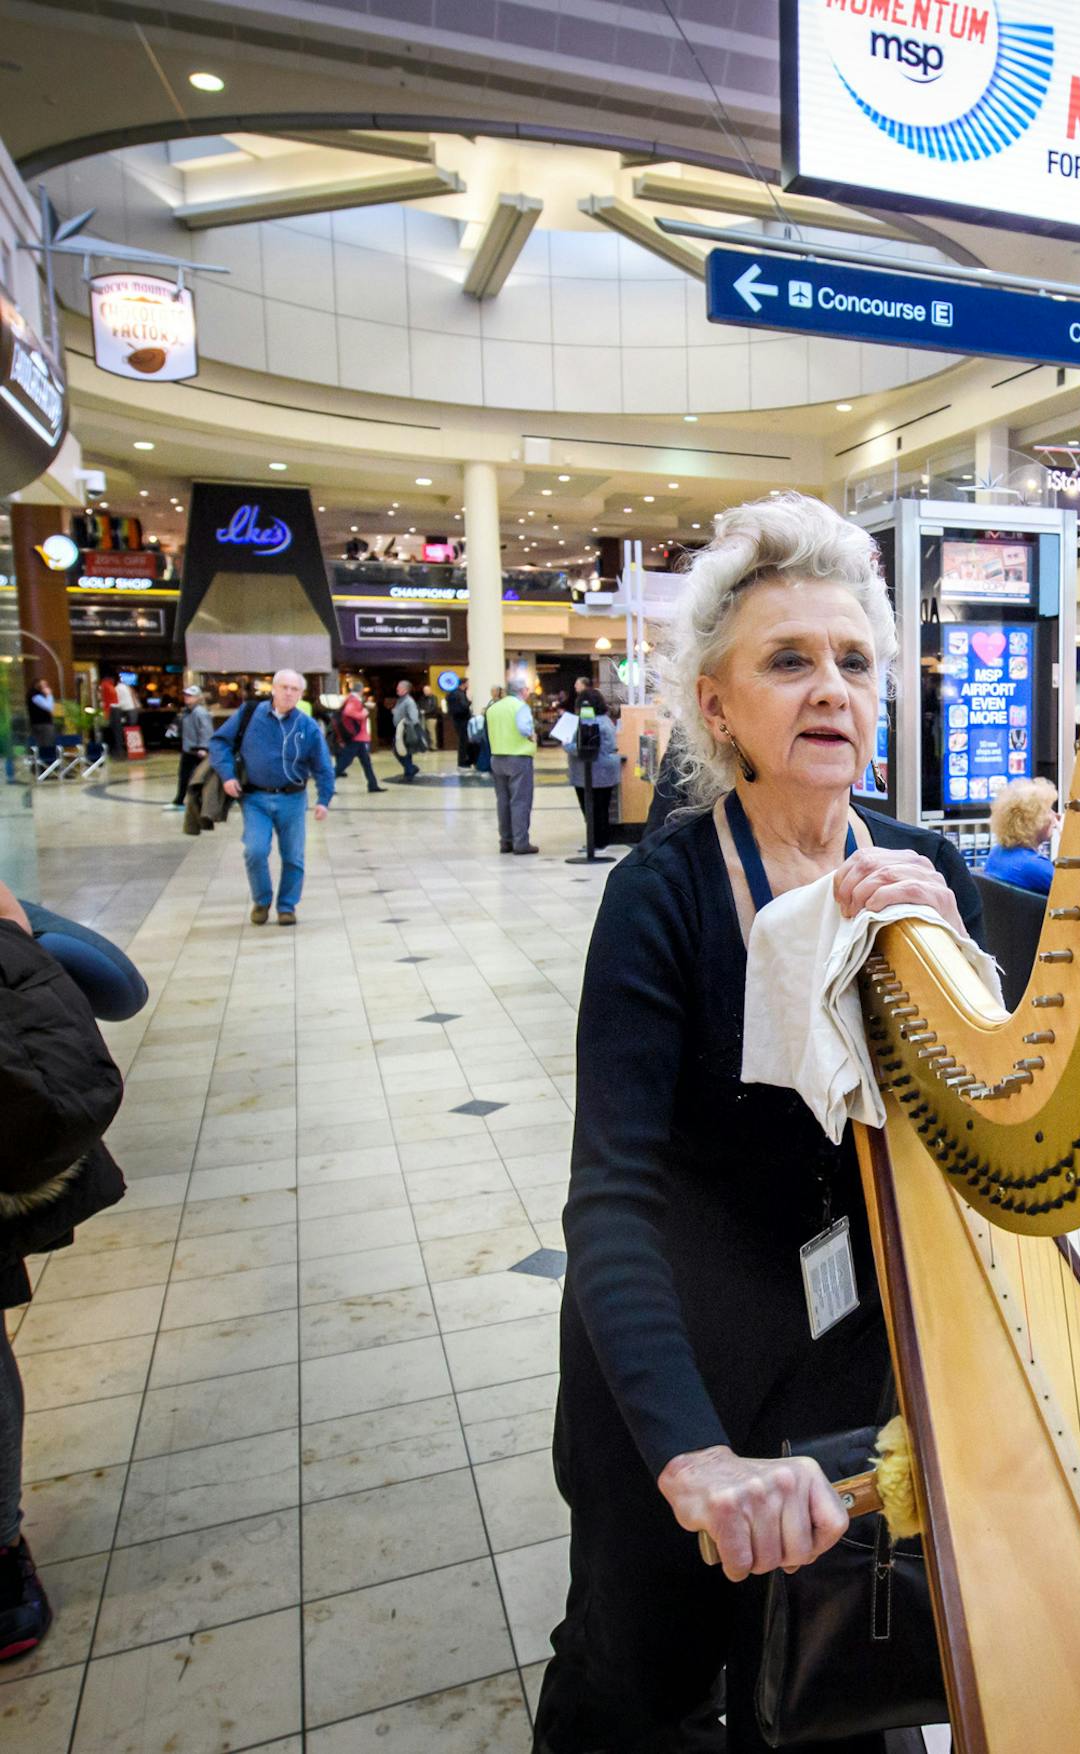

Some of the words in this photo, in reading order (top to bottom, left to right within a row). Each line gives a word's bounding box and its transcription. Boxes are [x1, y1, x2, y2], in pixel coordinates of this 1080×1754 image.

[826, 0, 989, 44] MENTUM
[871, 30, 943, 76] msp
[818, 287, 926, 321] Concourse
[933, 303, 951, 325] E
[78, 575, 115, 589] GOLF
[115, 576, 153, 590] SHOP
[975, 668, 1003, 682] MSP
[961, 683, 1017, 697] AIRPORT
[971, 697, 1007, 711] EVEN
[969, 711, 1008, 725] MORE
